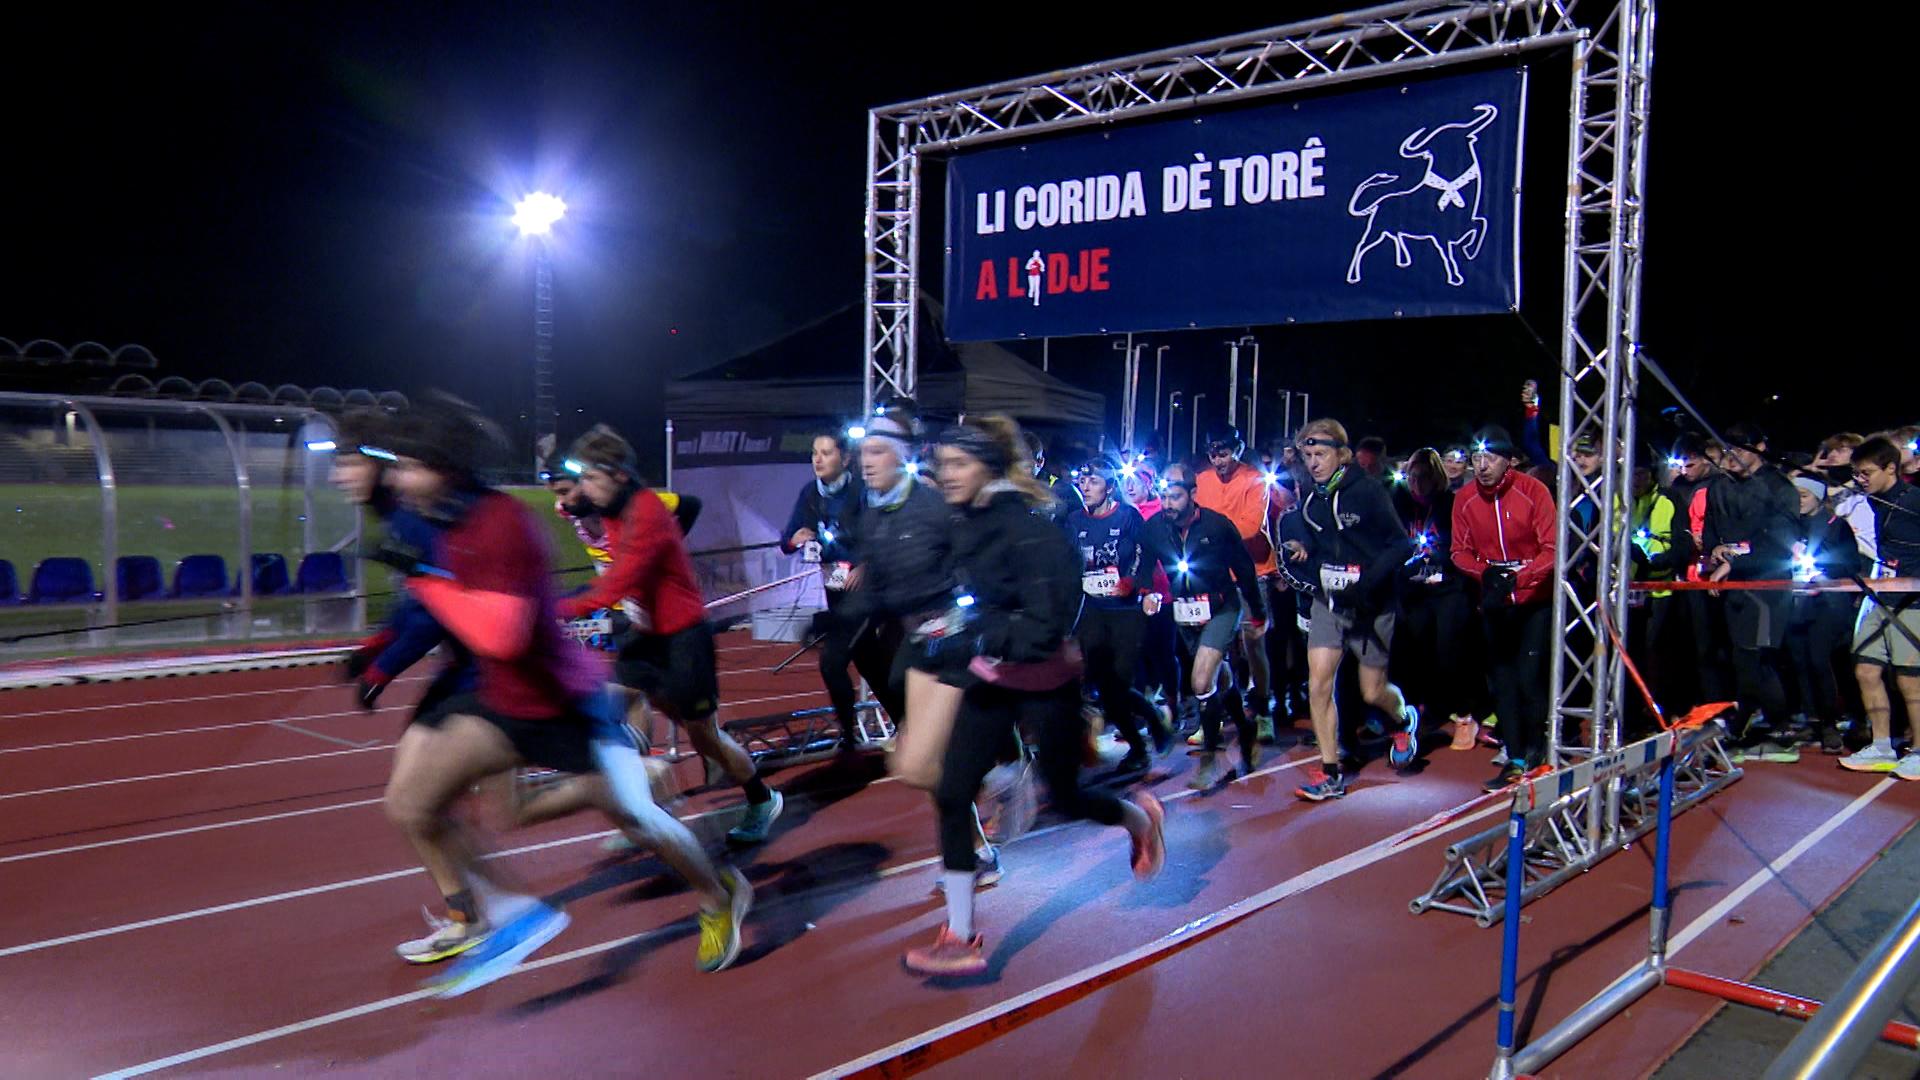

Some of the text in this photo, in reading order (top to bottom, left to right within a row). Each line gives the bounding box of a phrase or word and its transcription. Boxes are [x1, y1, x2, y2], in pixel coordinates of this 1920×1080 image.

[976, 136, 1326, 235] LI CORIDA DÈ TORÊ
[976, 259, 998, 301] A
